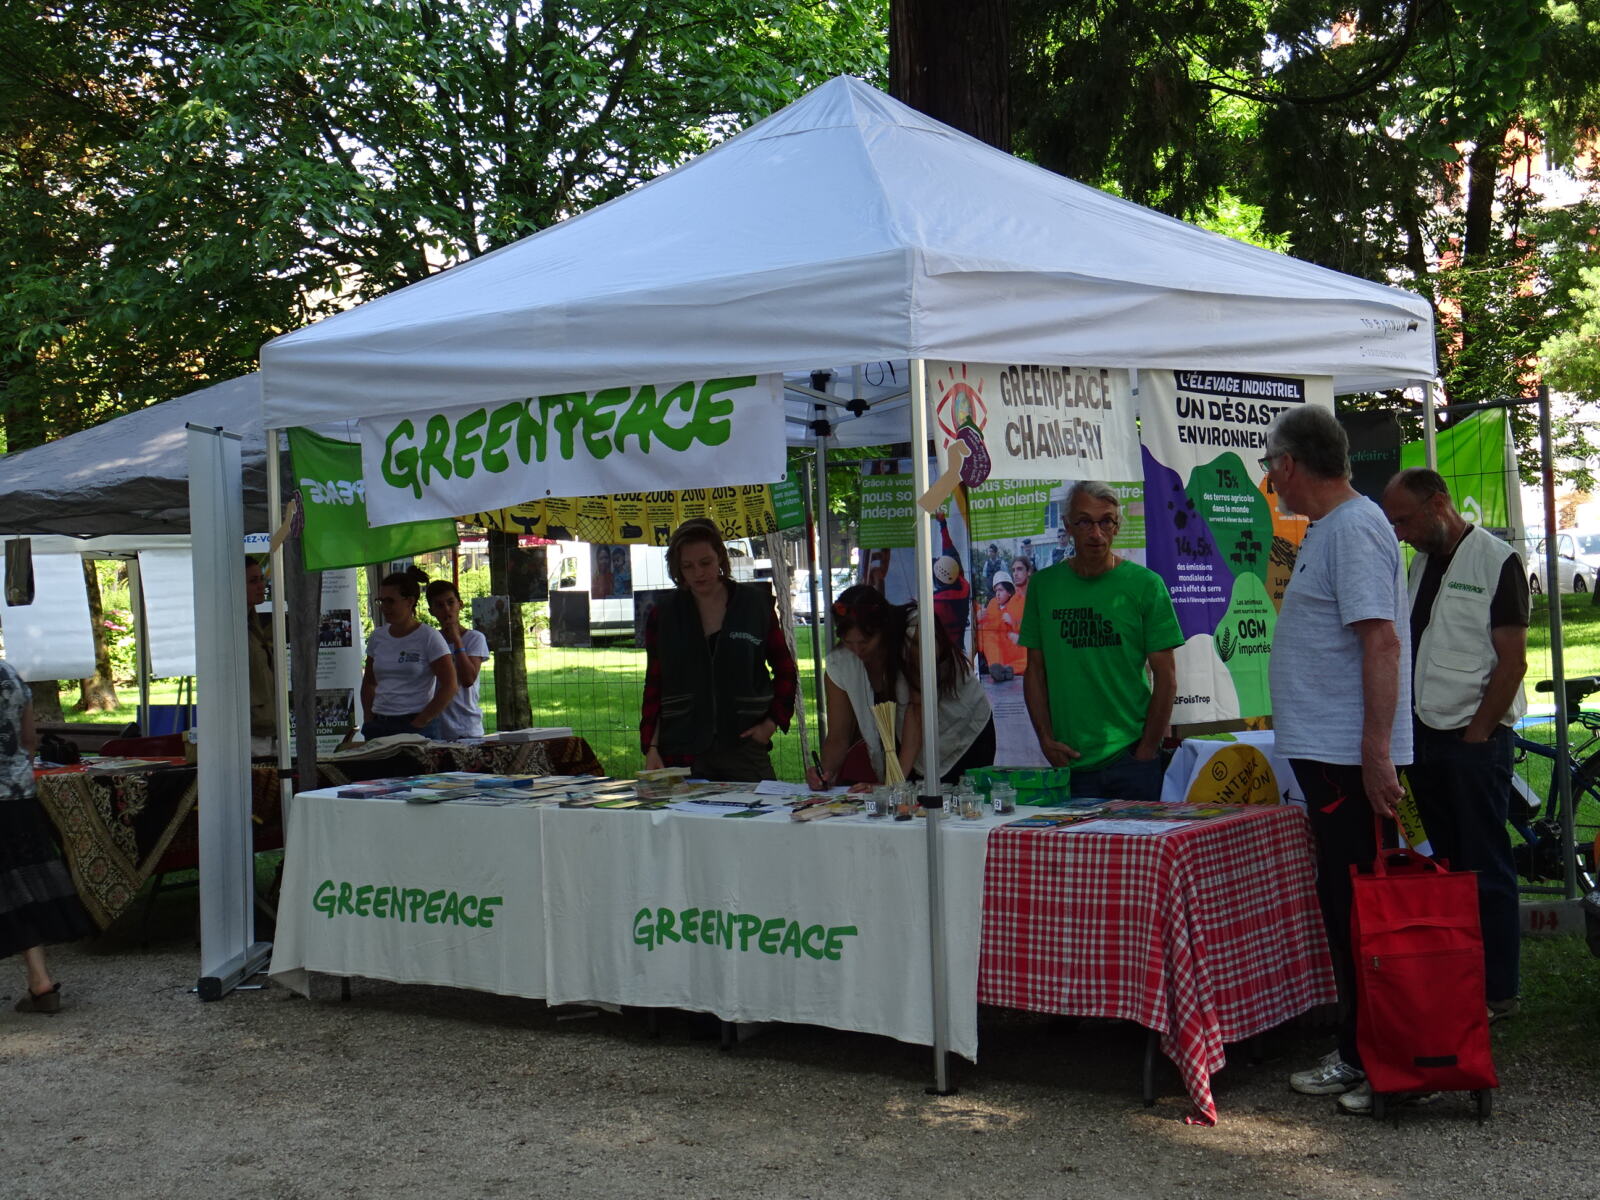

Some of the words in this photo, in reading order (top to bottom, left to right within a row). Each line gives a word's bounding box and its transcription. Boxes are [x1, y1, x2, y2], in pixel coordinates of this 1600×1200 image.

[1000, 364, 1112, 411] GREENPEACE
[1179, 370, 1240, 393] L'ÉLEVAGE
[1241, 378, 1301, 399] INDUSTRIEL
[1176, 397, 1205, 420] UN
[381, 375, 757, 499] GREENPEACE
[1005, 414, 1104, 461] CHAMBERY
[1215, 468, 1239, 489] 75%
[861, 491, 893, 503] nous
[969, 498, 994, 510] non
[1000, 490, 1047, 508] violents
[1238, 618, 1267, 639] OGM
[1238, 641, 1271, 656] importés
[312, 879, 503, 929] GREENPEACE
[633, 906, 859, 962] GREENPEACE
